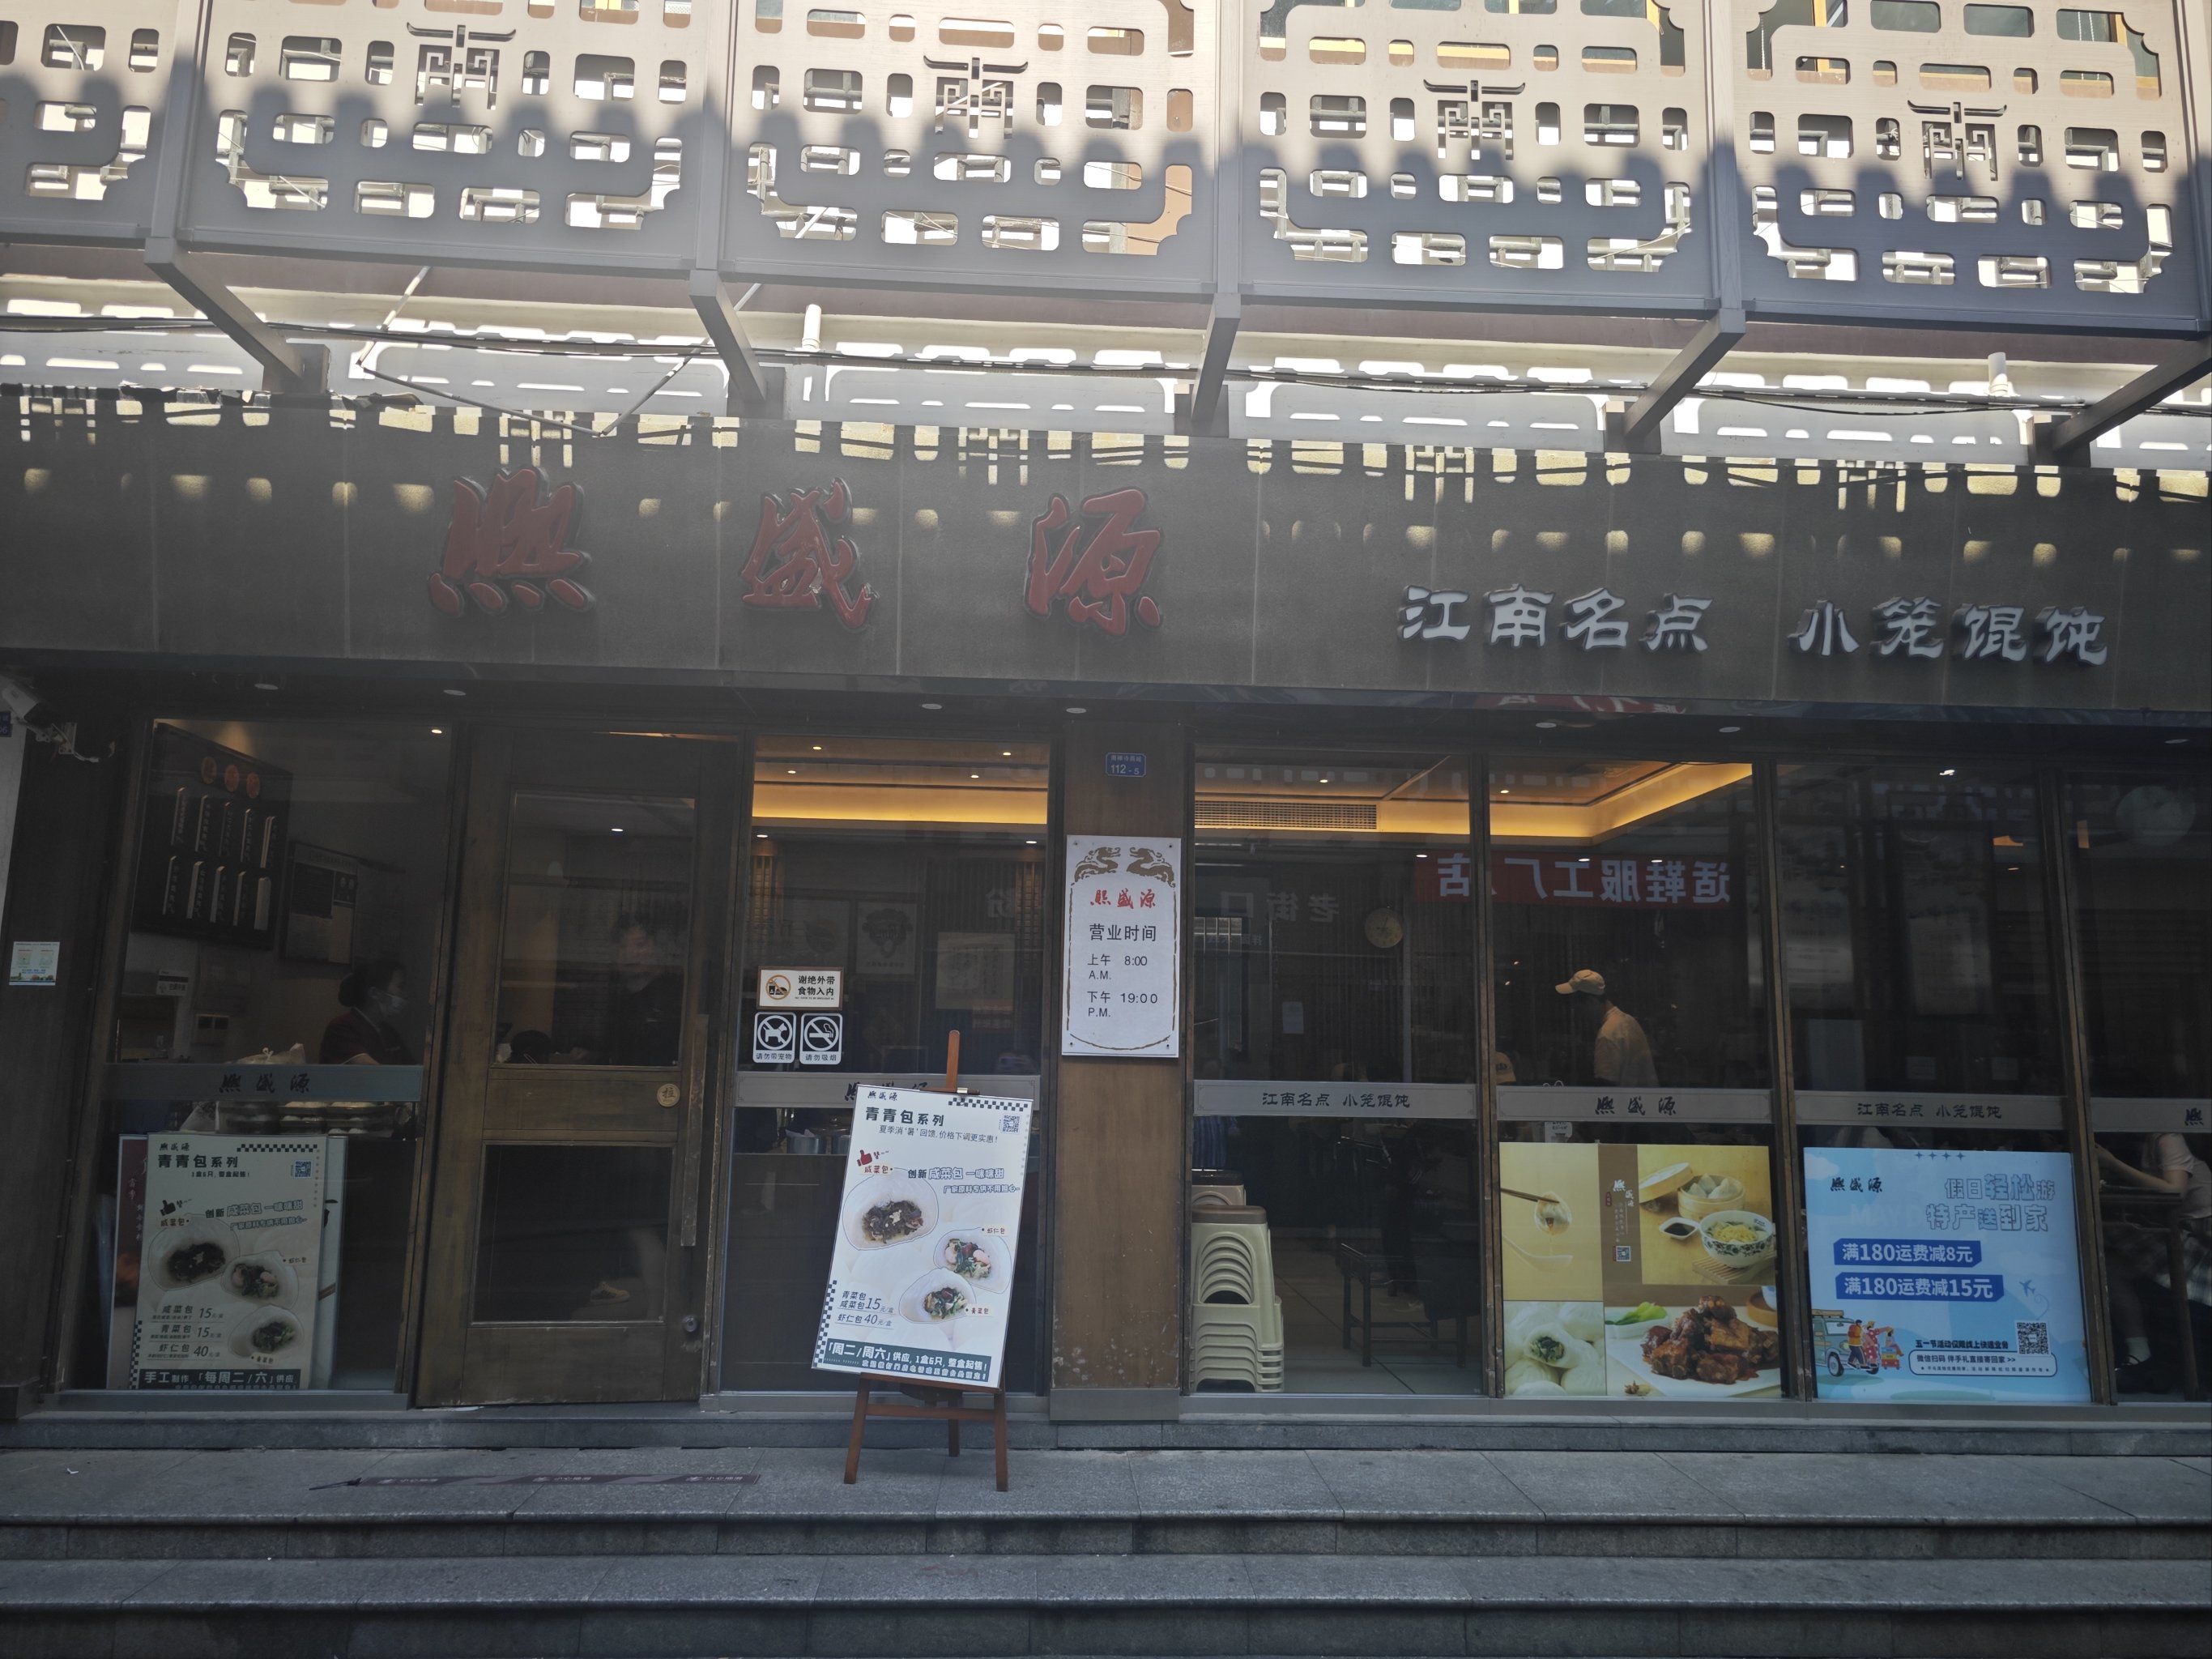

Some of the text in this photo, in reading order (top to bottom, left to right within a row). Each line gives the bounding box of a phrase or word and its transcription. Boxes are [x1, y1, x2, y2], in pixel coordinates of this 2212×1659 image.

[1401, 583, 2109, 667] 江南名点 小笼馄饨
[1089, 923, 1157, 942] 营业时间
[1087, 953, 1148, 966] 上午 8:00
[798, 975, 836, 986] 谢绝外带
[1089, 970, 1111, 980] A.M.
[797, 986, 834, 997] 食物入内
[1087, 991, 1157, 1004] 下午 19:00
[1087, 1007, 1110, 1017] P.M.
[756, 1052, 793, 1061] 请勿带宠物
[805, 1053, 837, 1062] 请勿吸烟
[1262, 1091, 1412, 1109] 江南名点 小笼馄饨
[865, 1106, 945, 1127] 青青包系列
[1856, 1102, 2003, 1120] 江南名点 小笼馄饨
[158, 1154, 238, 1168] 青青包系列
[864, 1165, 889, 1174] 咸菜包
[907, 1168, 927, 1179] 创新
[928, 1167, 964, 1180] 咸菜包
[1944, 1173, 2056, 1201] 假日轻松游
[226, 1202, 262, 1218] 咸菜包
[1925, 1203, 2049, 1232] 特产送到家
[987, 1226, 1005, 1235] 虾仁包
[1843, 1242, 1974, 1264] 满180运费减8元
[1844, 1275, 1994, 1299] 满180运费减15元
[842, 1290, 867, 1301] 青菜包
[162, 1305, 194, 1314] 咸菜包
[839, 1300, 864, 1310] 咸菜包
[837, 1314, 863, 1324] 虾仁包
[160, 1324, 192, 1333] 青菜包
[158, 1343, 190, 1353] 虾仁包
[145, 1371, 190, 1384] 手工制作
